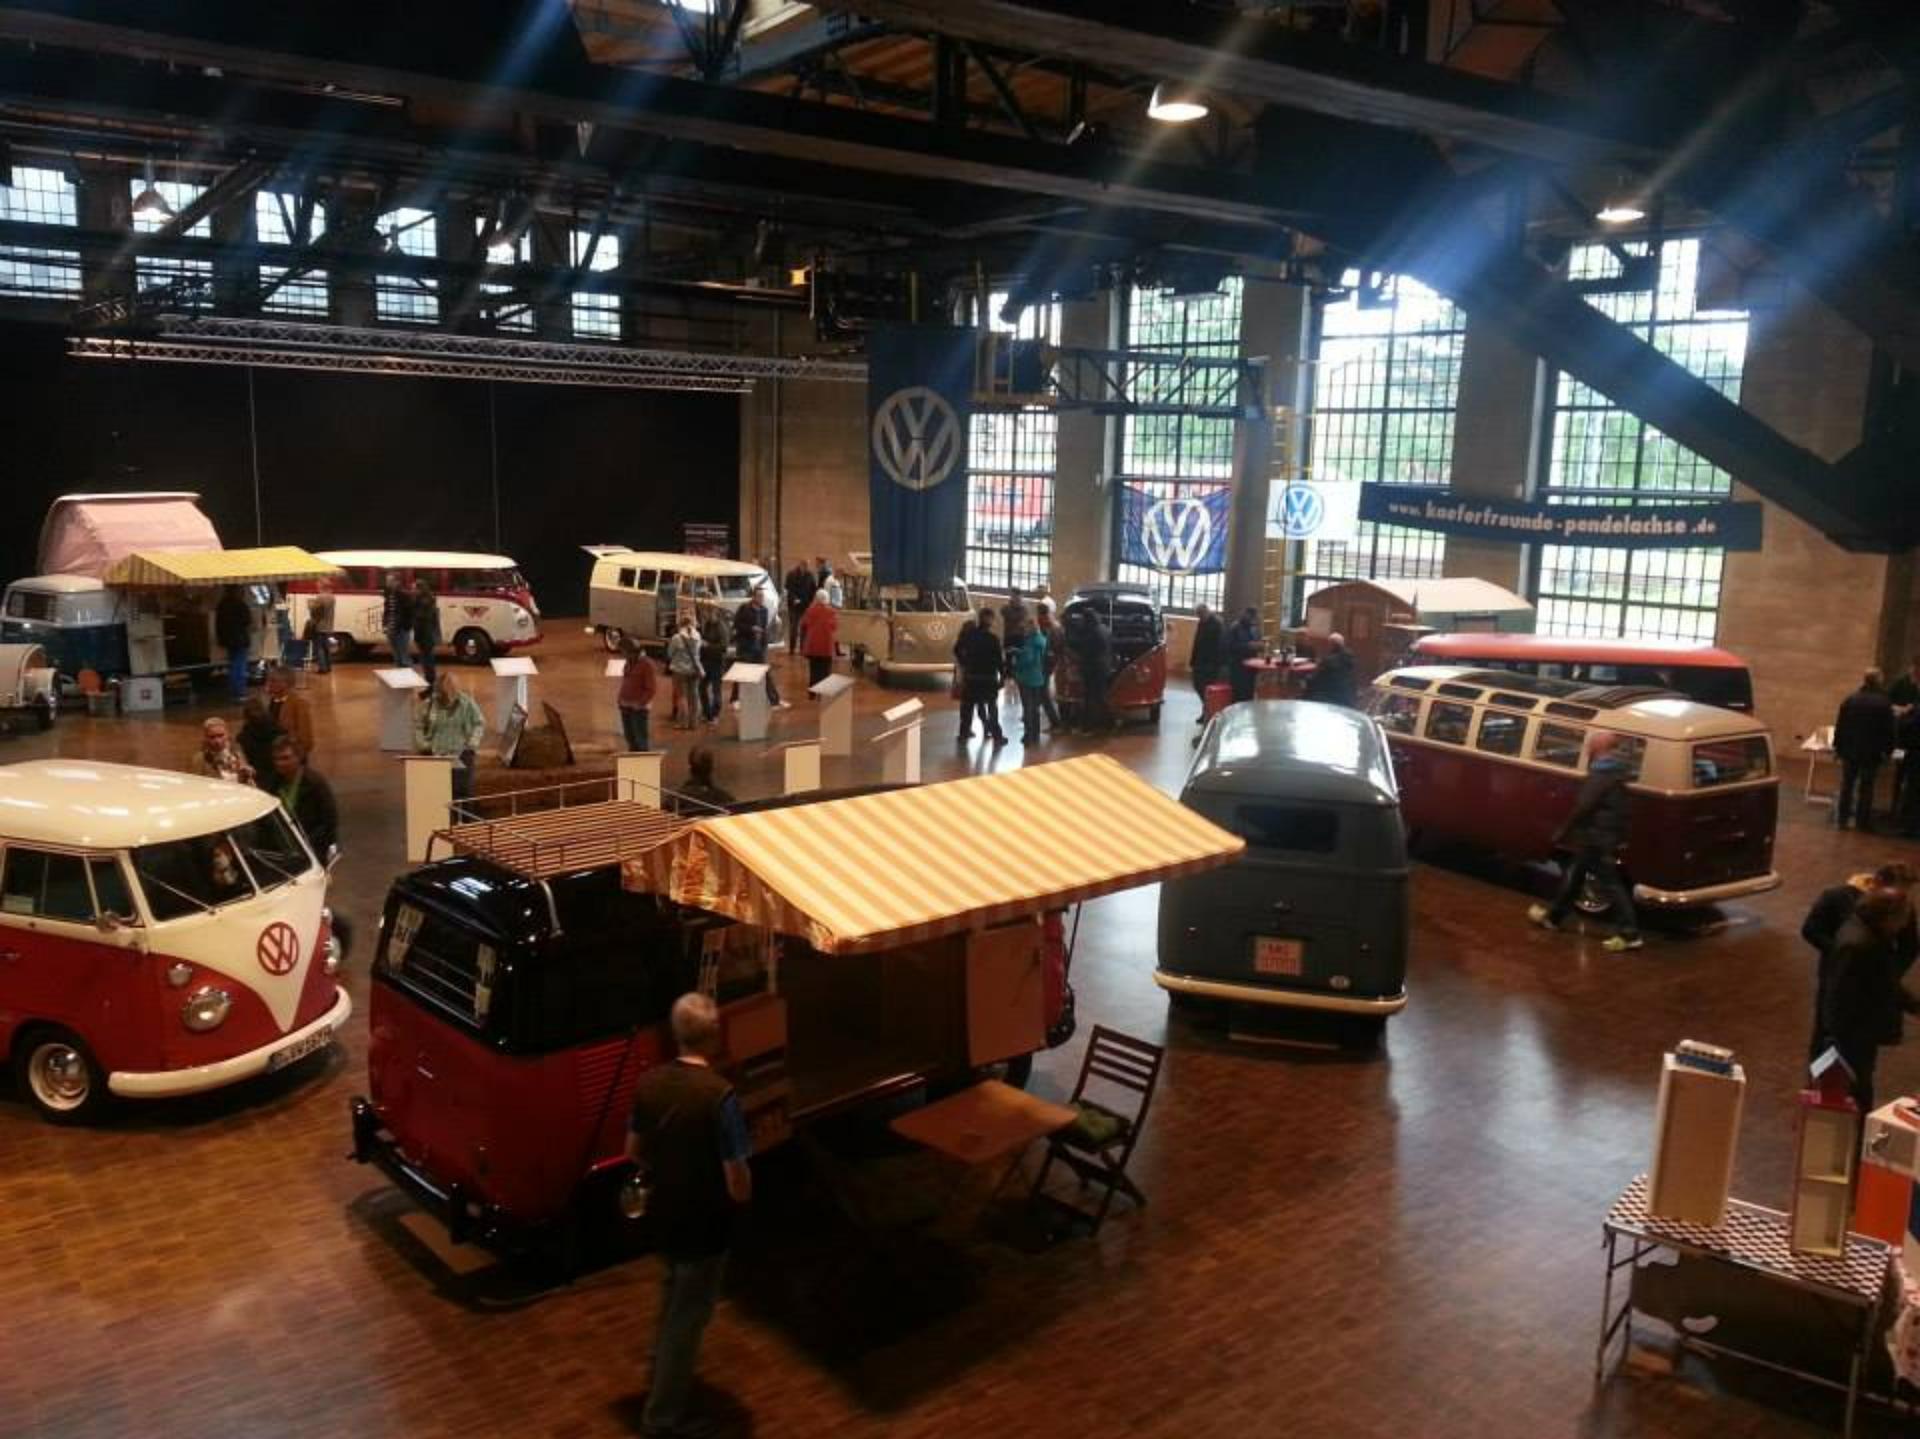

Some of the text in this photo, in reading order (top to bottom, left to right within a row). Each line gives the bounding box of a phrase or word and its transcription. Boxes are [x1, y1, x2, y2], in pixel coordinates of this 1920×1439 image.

[873, 387, 962, 490] VW
[1141, 498, 1212, 576] VW
[1281, 484, 1324, 536] VW
[258, 922, 299, 976] VW
